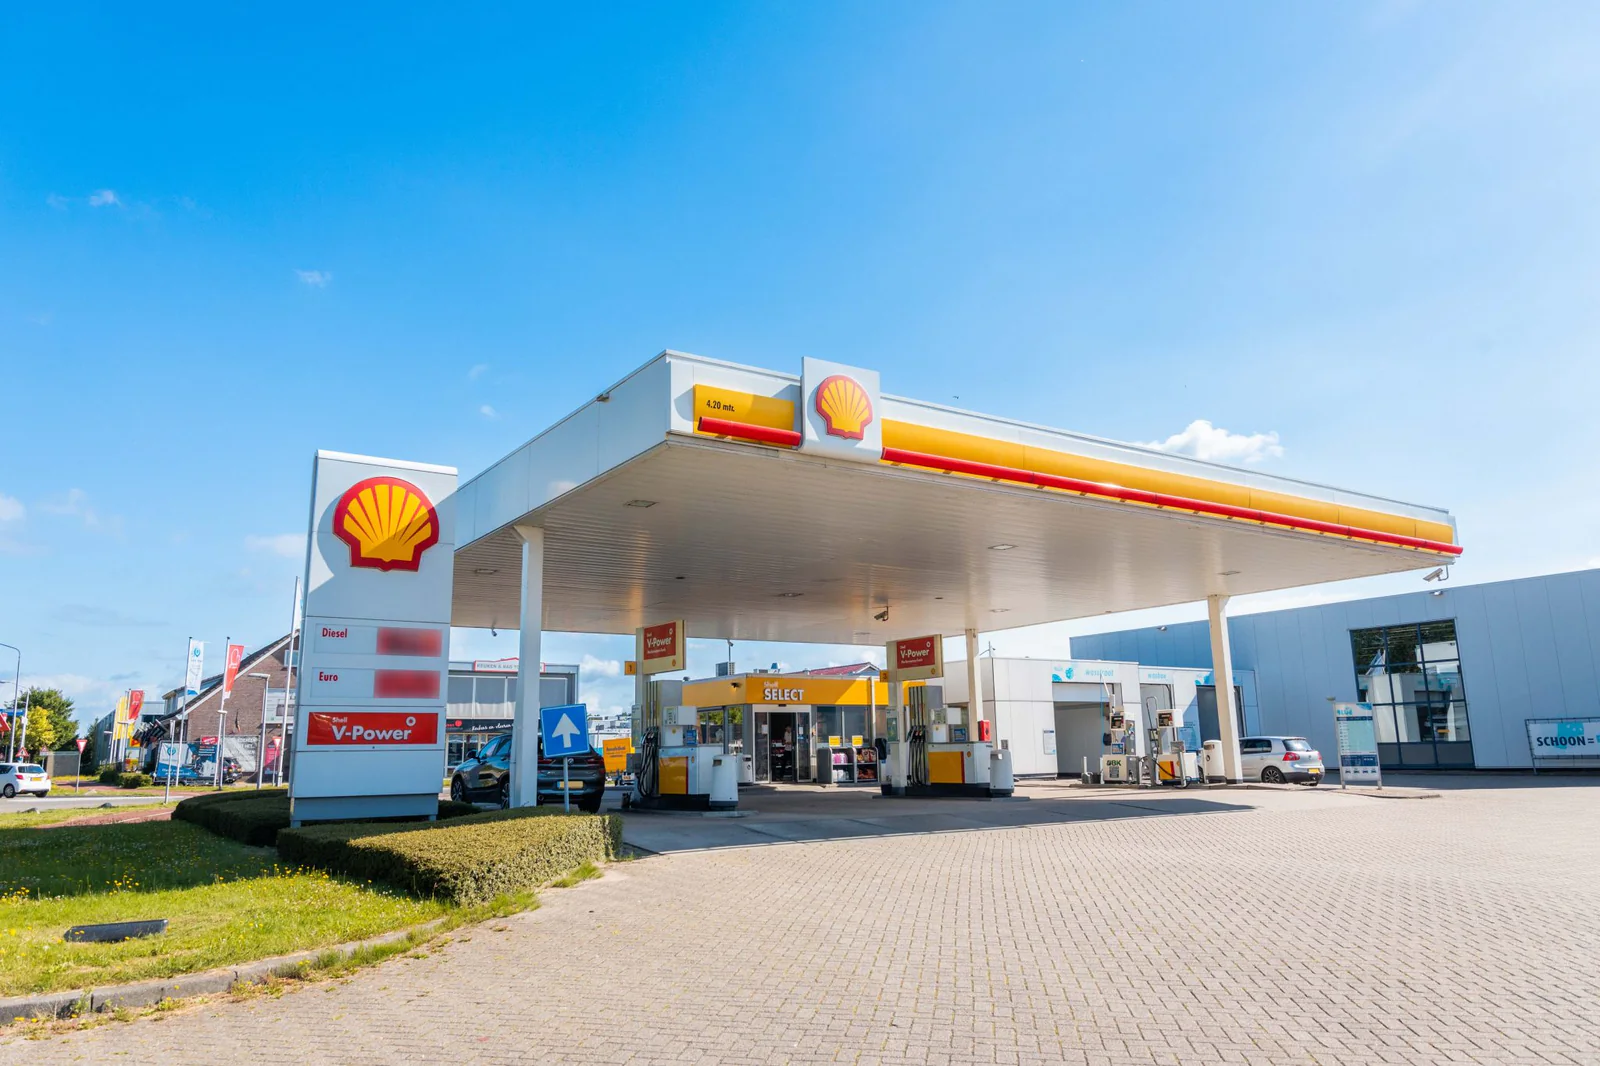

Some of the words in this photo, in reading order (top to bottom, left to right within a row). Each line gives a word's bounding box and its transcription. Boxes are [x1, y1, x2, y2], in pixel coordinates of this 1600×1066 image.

[706, 400, 721, 409] 4.20
[322, 627, 348, 638] Diesel
[646, 637, 672, 648] V-Power
[900, 649, 930, 659] V-Power
[319, 671, 339, 681] Euro
[764, 688, 805, 701] SELECT
[332, 725, 412, 740] V-Power
[1536, 736, 1586, 747] SCHOON
